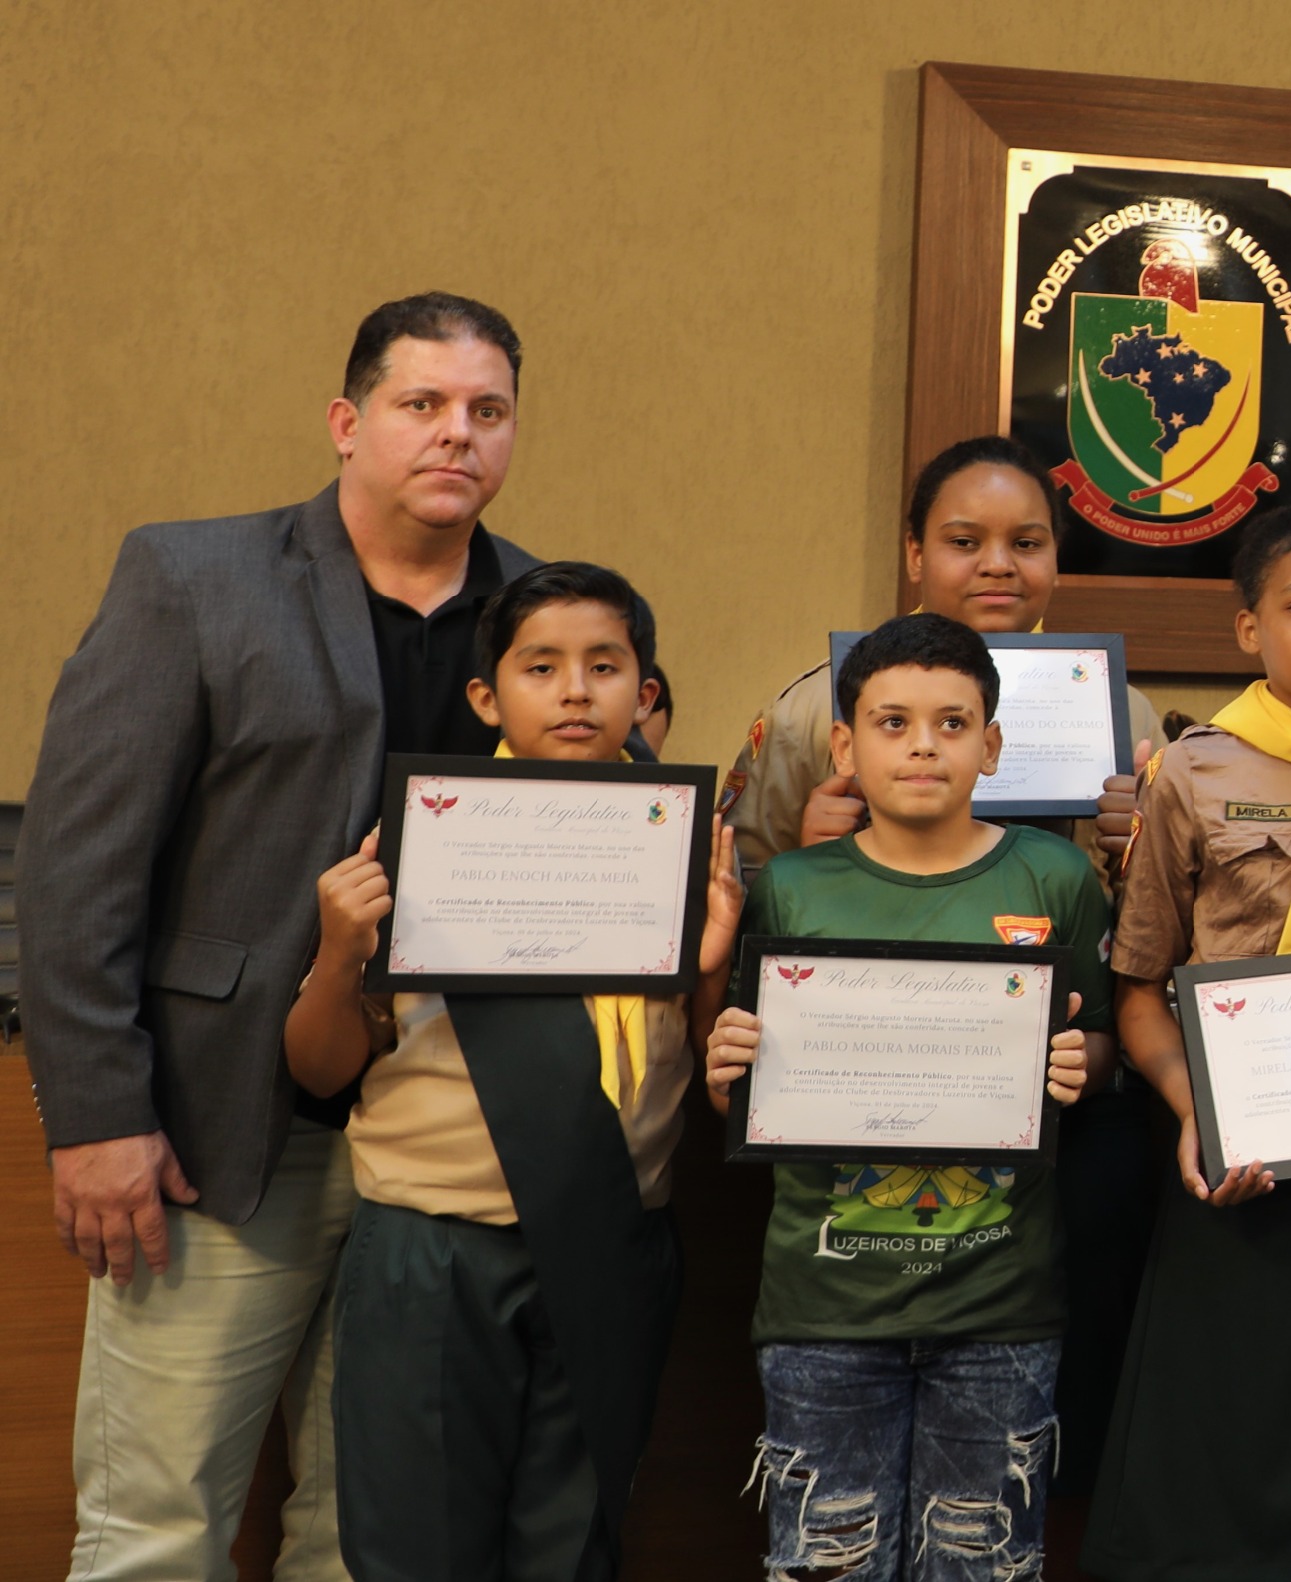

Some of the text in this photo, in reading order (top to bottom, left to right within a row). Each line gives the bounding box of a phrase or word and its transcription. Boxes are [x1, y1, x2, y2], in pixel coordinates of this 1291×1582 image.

[1022, 247, 1084, 330] PODER
[1078, 202, 1229, 255] LEGISLATIVO
[1083, 502, 1246, 541] O PODER UNIDO É MAIS FORTE
[1002, 720, 1104, 729] XIMO DO CARMO
[464, 797, 632, 826] Poder Legislativo
[1235, 807, 1287, 818] MIRELA
[451, 869, 639, 884] PABLO ENOCH APAZA MEJÍA
[821, 968, 990, 998] Poder Legislativo
[803, 1040, 1002, 1057] PABLO MOURA MORAIS FARIA
[854, 1070, 920, 1078] Reconhecimento
[813, 1215, 1012, 1260] LUZEIROS DE VIÇOSA
[901, 1262, 942, 1274] 2024
